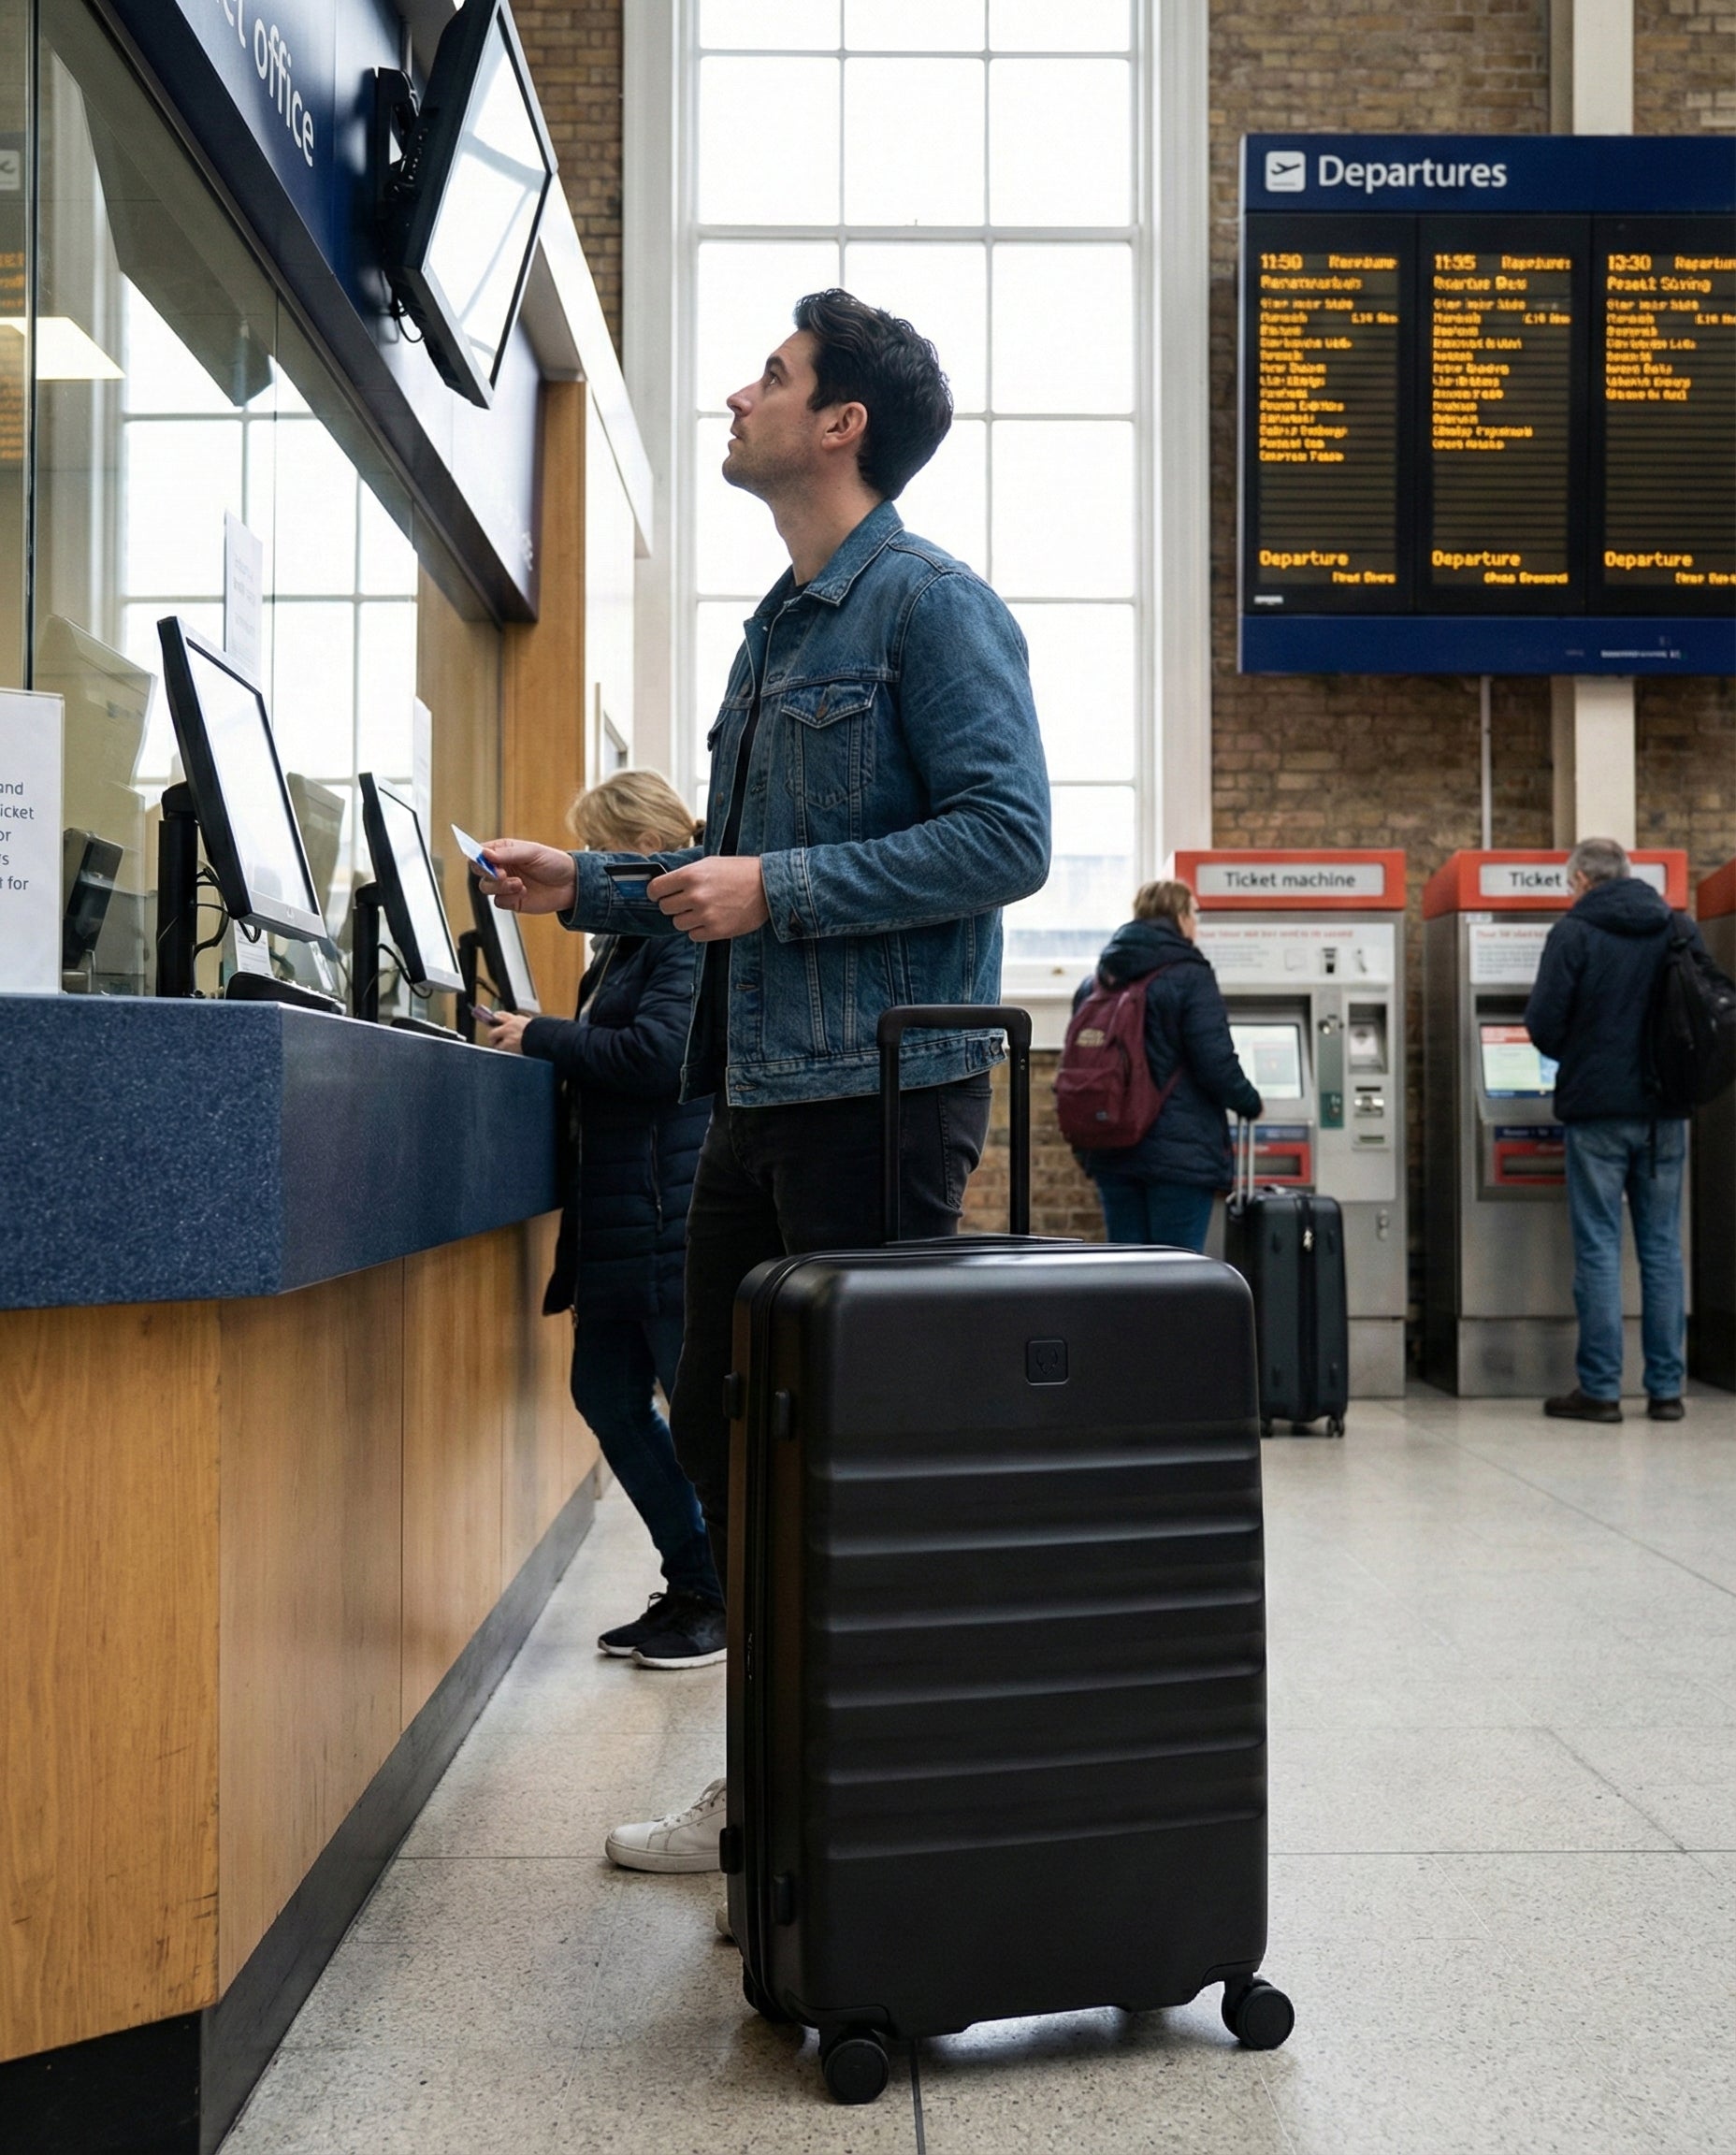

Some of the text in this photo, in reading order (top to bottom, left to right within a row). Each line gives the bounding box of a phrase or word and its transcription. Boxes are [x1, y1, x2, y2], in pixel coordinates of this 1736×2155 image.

[253, 18, 314, 167] office
[1319, 154, 1508, 195] Departures
[1259, 549, 1350, 570] Departure
[1431, 549, 1521, 570] Departure
[1604, 550, 1694, 571] Departure
[7, 875, 29, 889] for
[1224, 871, 1356, 888] Ticket machine
[1509, 871, 1562, 888] Ticket
